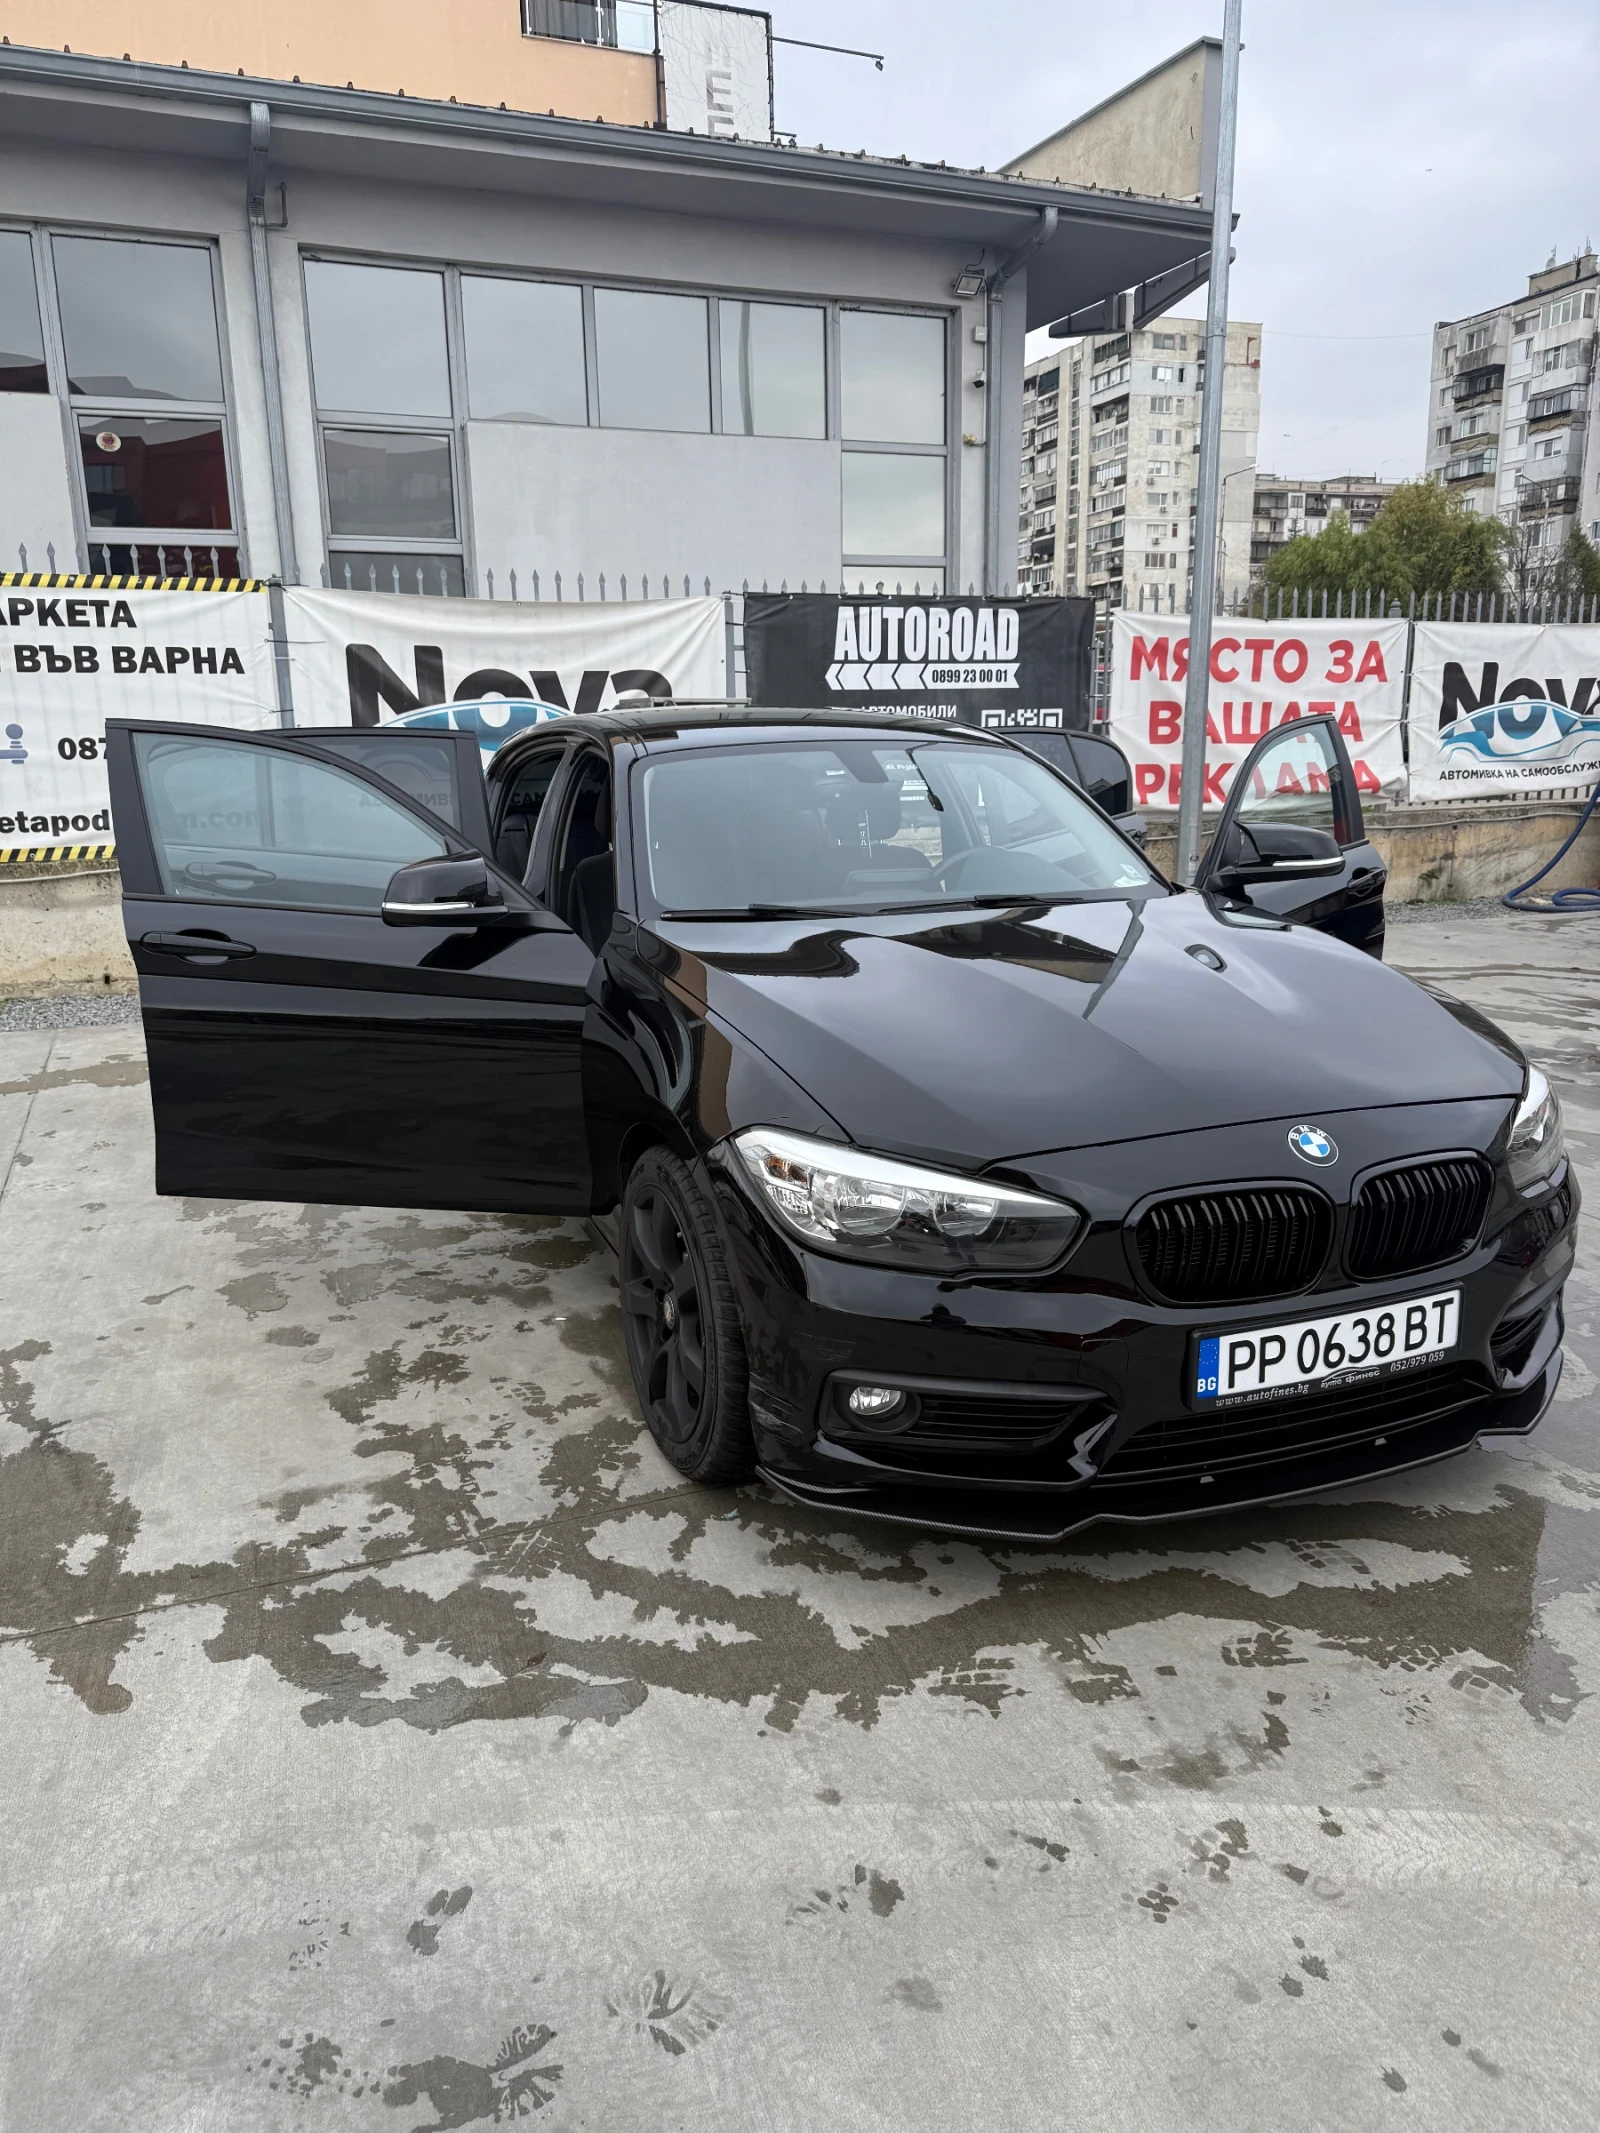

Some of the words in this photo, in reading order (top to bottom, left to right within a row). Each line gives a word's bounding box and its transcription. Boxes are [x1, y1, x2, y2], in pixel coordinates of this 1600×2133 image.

[833, 606, 1020, 662] AUTOROAD
[14, 644, 100, 674] ВЪВ
[112, 646, 246, 675] ВАРНА
[1325, 639, 1388, 683] ЗА
[932, 669, 961, 684] 0899
[963, 669, 977, 684] 23
[979, 669, 993, 684] 00
[995, 669, 1008, 684] 01
[1439, 769, 1504, 781] АВТОМИВКА
[1505, 769, 1520, 779] НА
[1197, 1376, 1217, 1393] BG
[1228, 1335, 1286, 1389] PP
[1297, 1312, 1395, 1374] 0638
[1404, 1297, 1454, 1352] BT
[1390, 1353, 1427, 1372] 052/979
[1428, 1350, 1445, 1364] 059
[1216, 1383, 1310, 1407] www.autofines.bg
